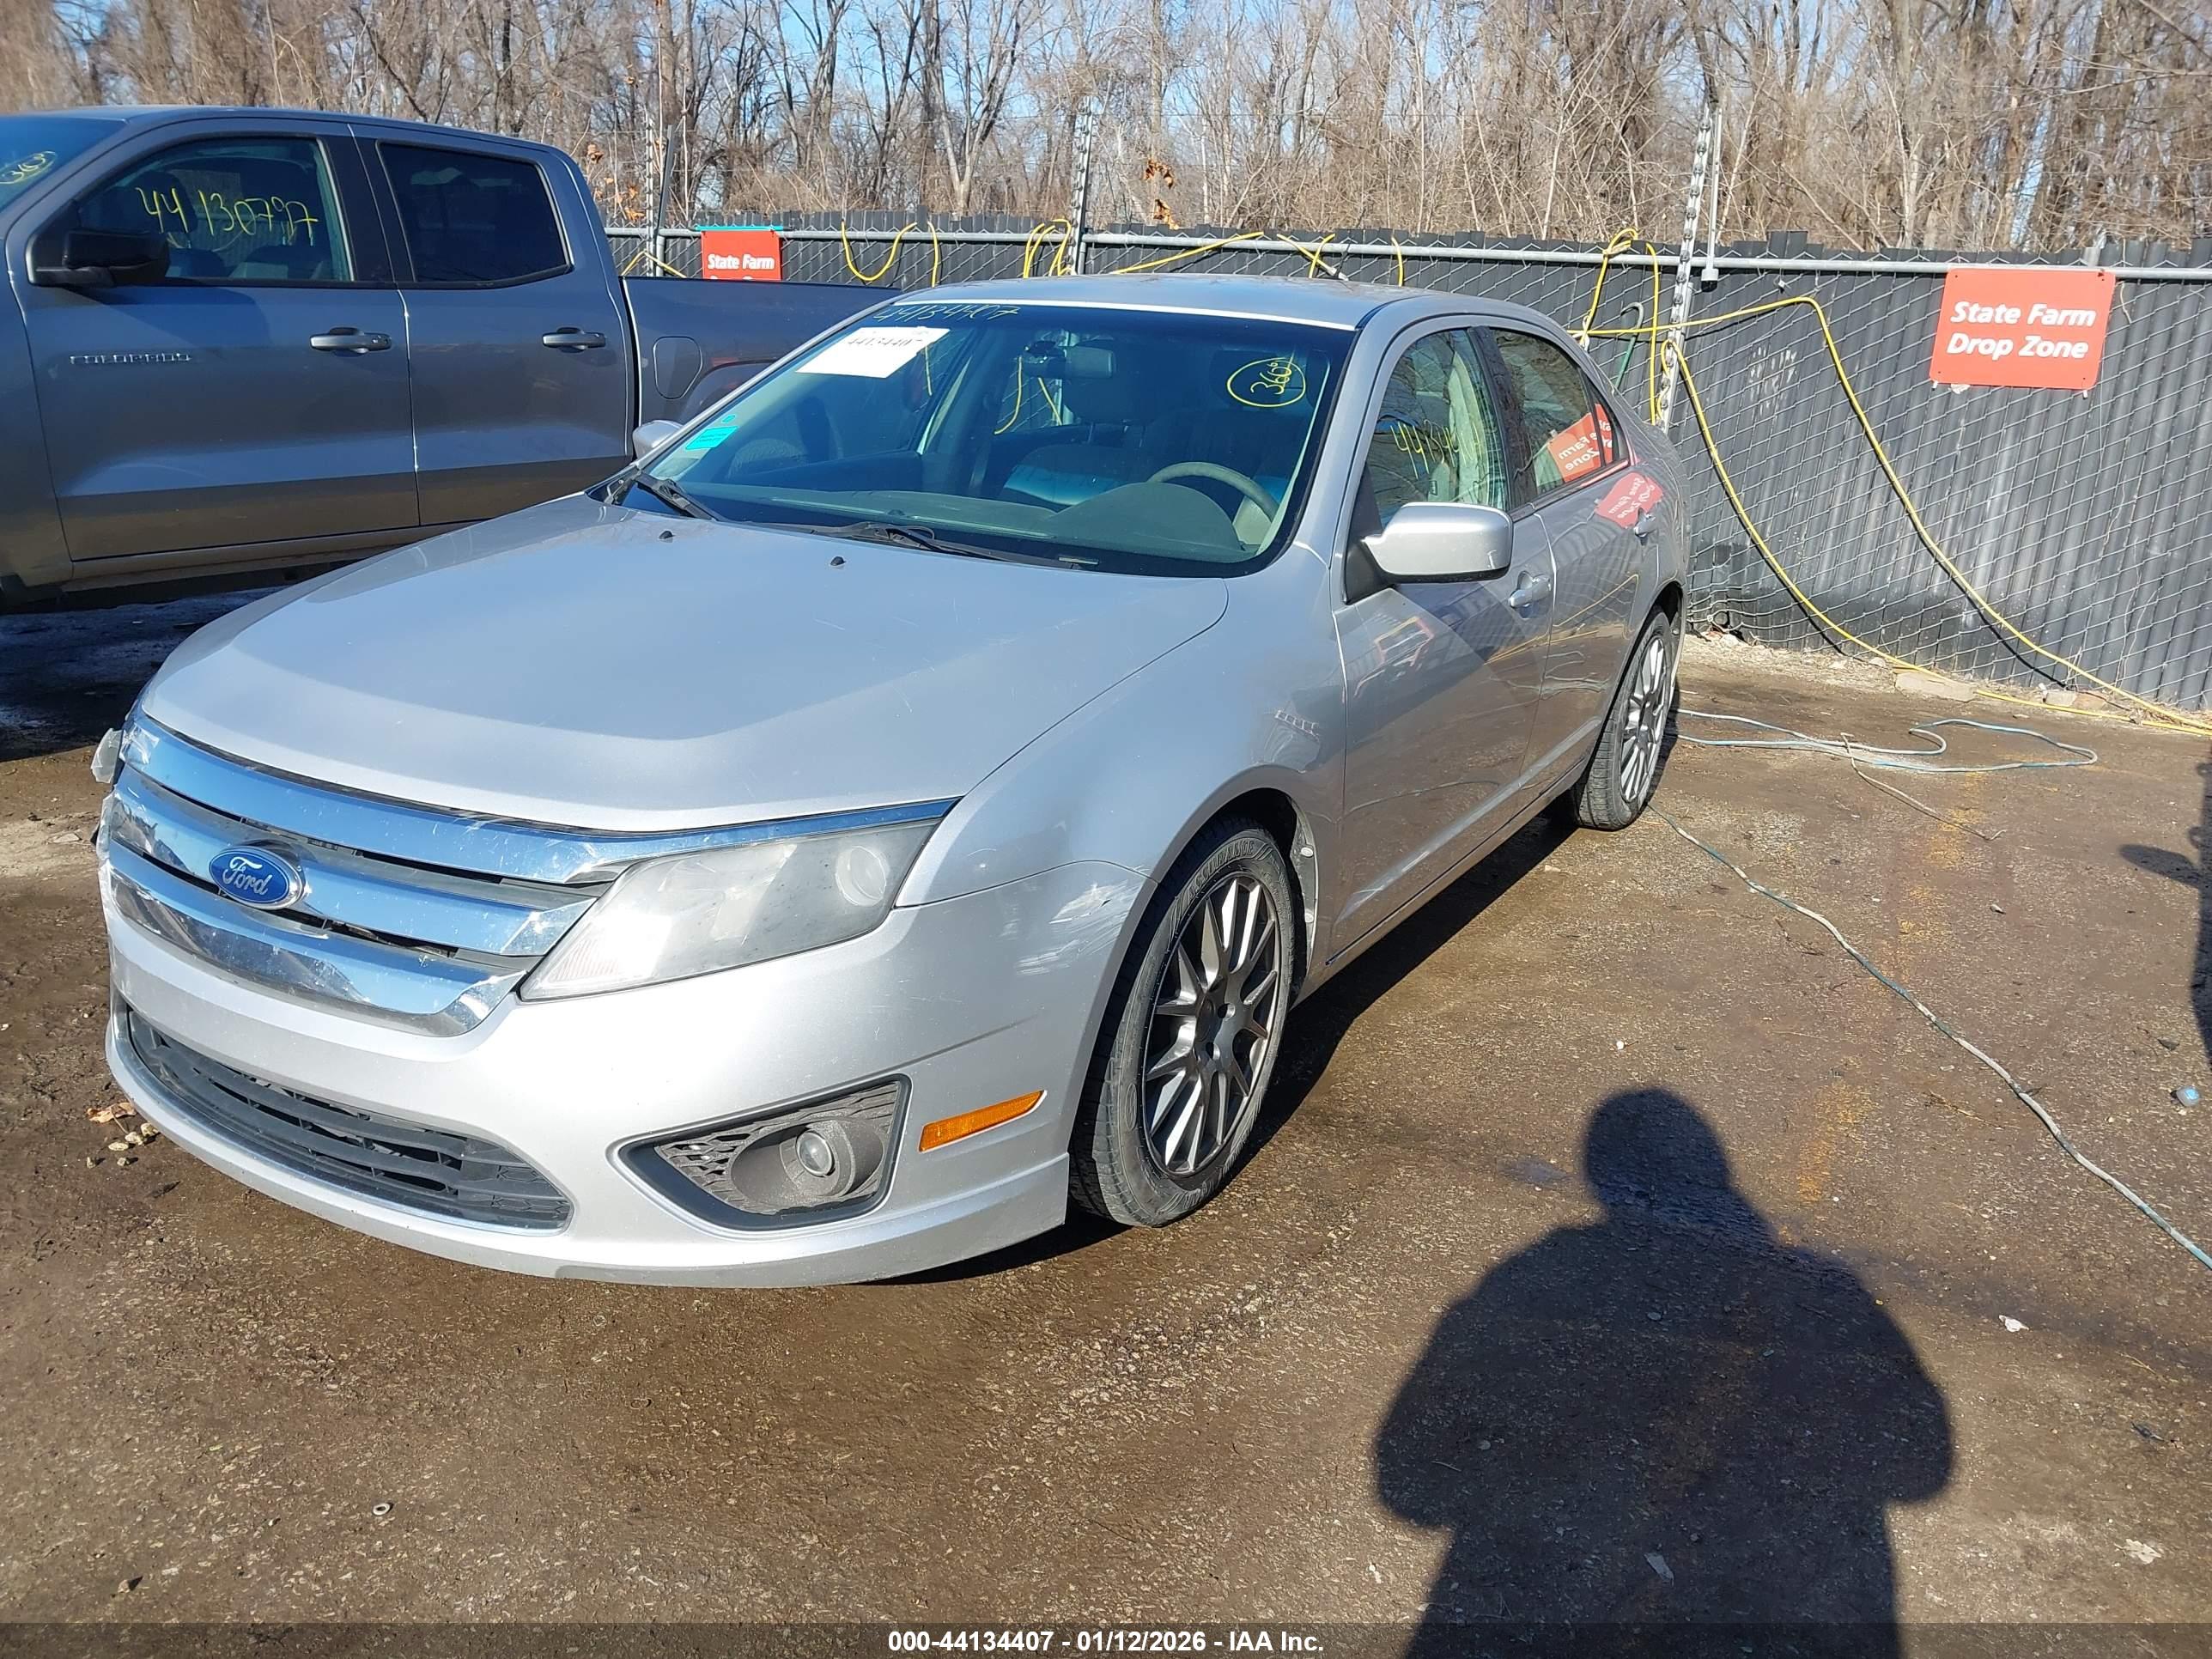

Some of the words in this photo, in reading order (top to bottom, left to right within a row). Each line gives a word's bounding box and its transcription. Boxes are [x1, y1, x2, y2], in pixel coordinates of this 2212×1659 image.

[708, 253, 739, 269] State
[742, 253, 775, 269] Farm
[1950, 301, 2021, 325] State
[2027, 303, 2096, 326] Farm
[1947, 332, 2014, 361] Drop
[2019, 335, 2089, 359] Zone
[222, 856, 273, 896] Ford
